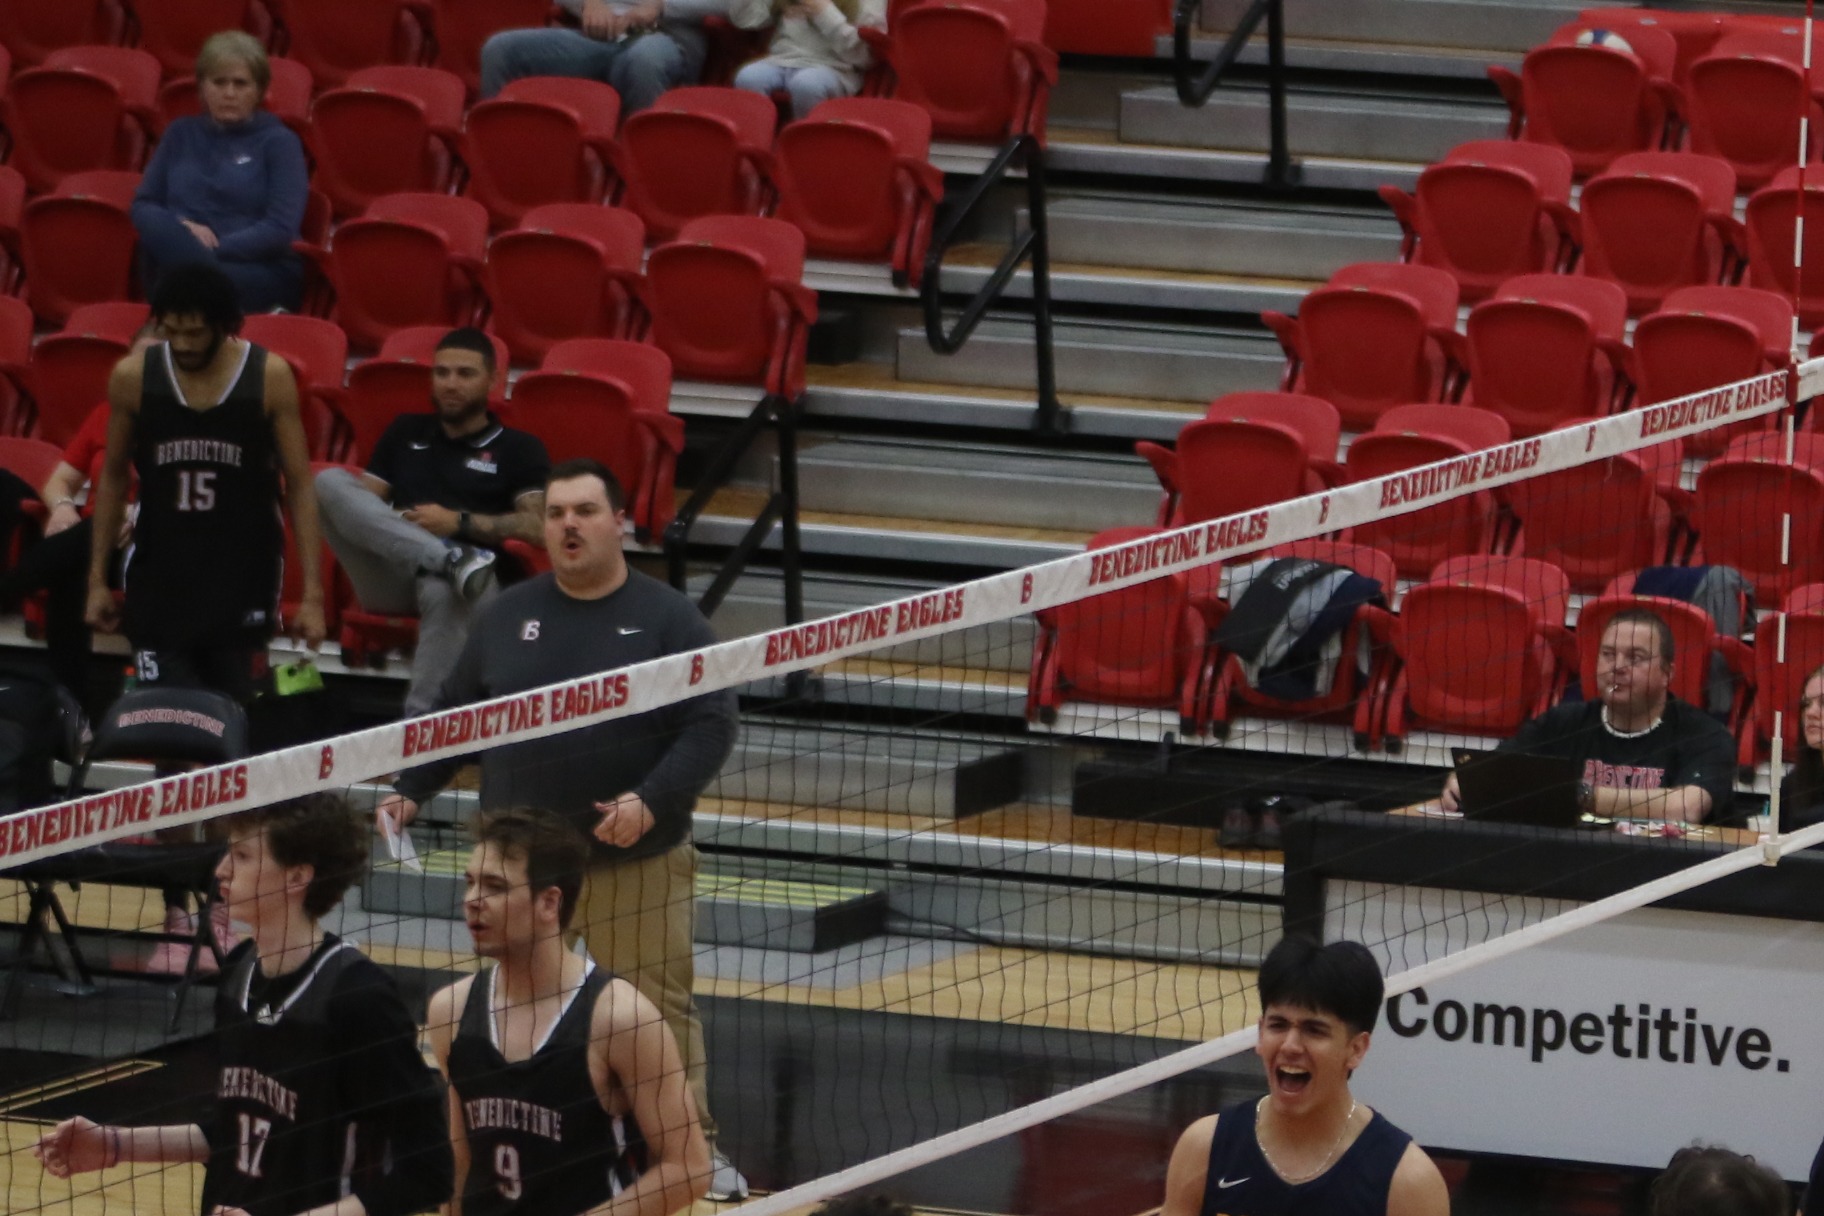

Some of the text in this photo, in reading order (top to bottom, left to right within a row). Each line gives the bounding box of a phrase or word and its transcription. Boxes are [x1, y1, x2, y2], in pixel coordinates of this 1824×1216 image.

[158, 440, 242, 467] BENEDICTINE
[1482, 439, 1542, 480] EAGLES
[178, 472, 217, 511] 15
[1089, 511, 1269, 586] BENEDICTINE EAGLES
[764, 588, 966, 666] BENEDICTINE EAGLES
[136, 651, 160, 681] 15
[690, 654, 704, 686] B
[118, 708, 226, 738] BENEDICTINE
[403, 674, 630, 758] BENEDICTINE EAGLES
[318, 744, 334, 780] B
[0, 765, 249, 856] BENEDICTINE EAGLES
[1386, 986, 1791, 1073] Competitive.
[238, 1112, 271, 1178] 17
[495, 1145, 522, 1200] 9
